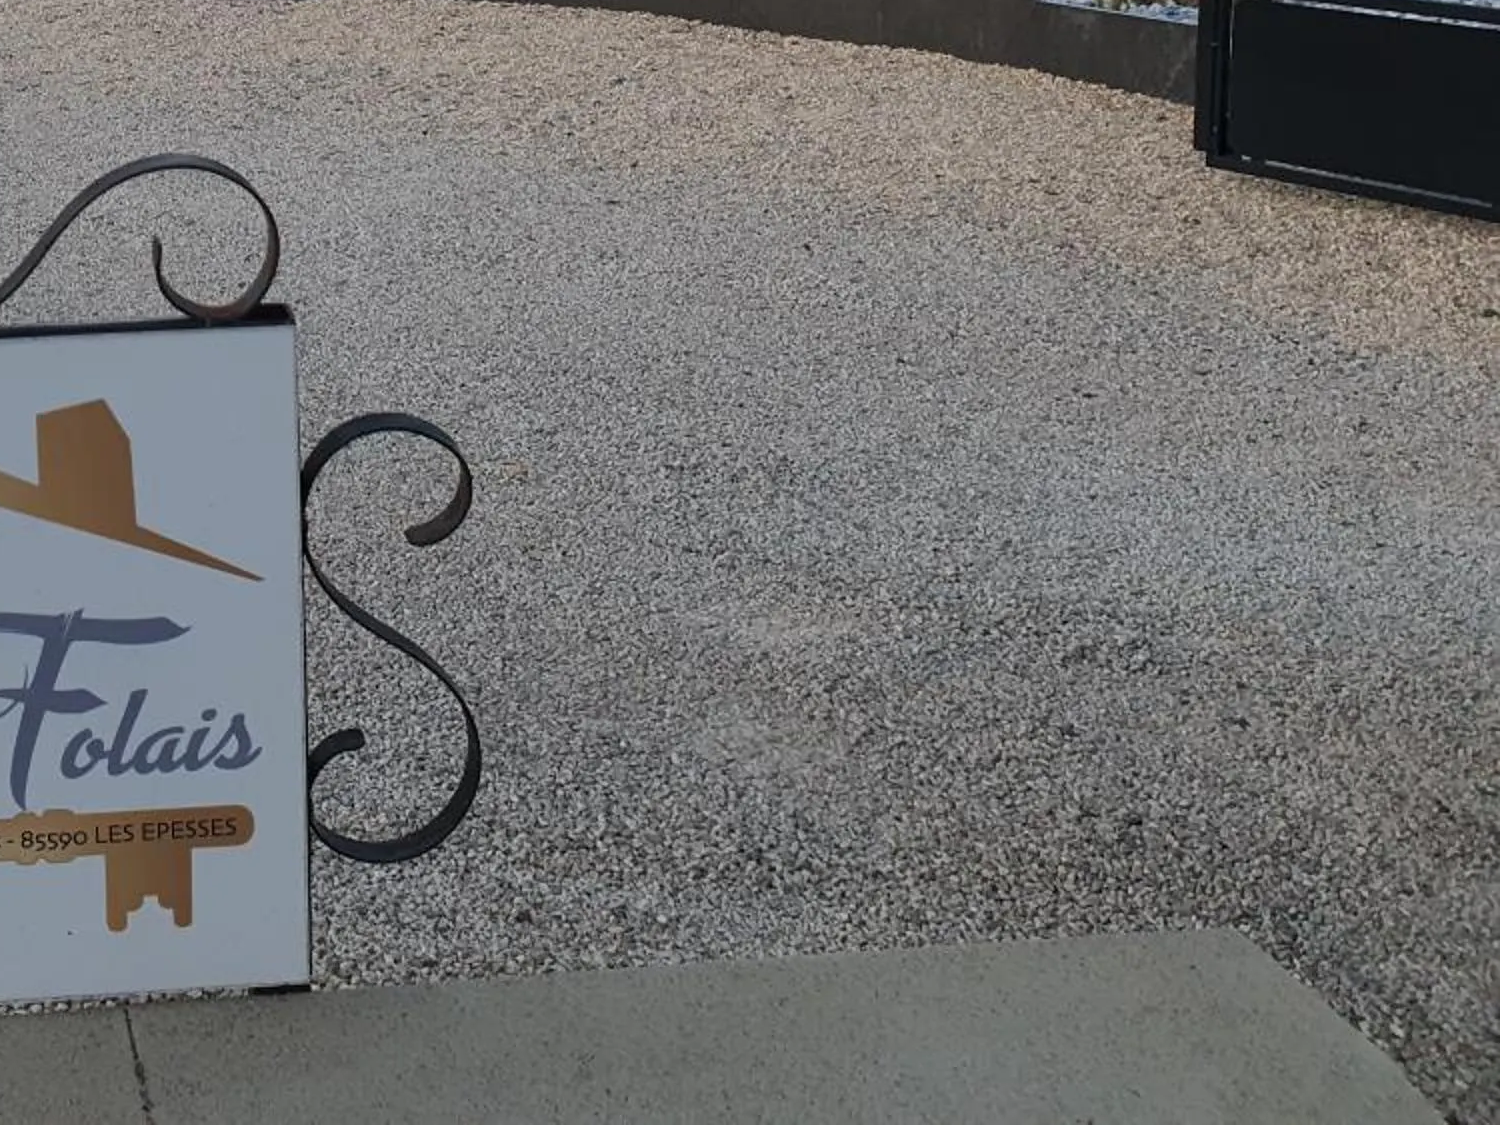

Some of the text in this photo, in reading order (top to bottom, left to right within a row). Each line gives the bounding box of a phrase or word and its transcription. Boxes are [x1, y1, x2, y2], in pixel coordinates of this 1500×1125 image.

[20, 829, 88, 852] 85590
[94, 825, 135, 845] LES
[143, 817, 237, 840] EPESSES
